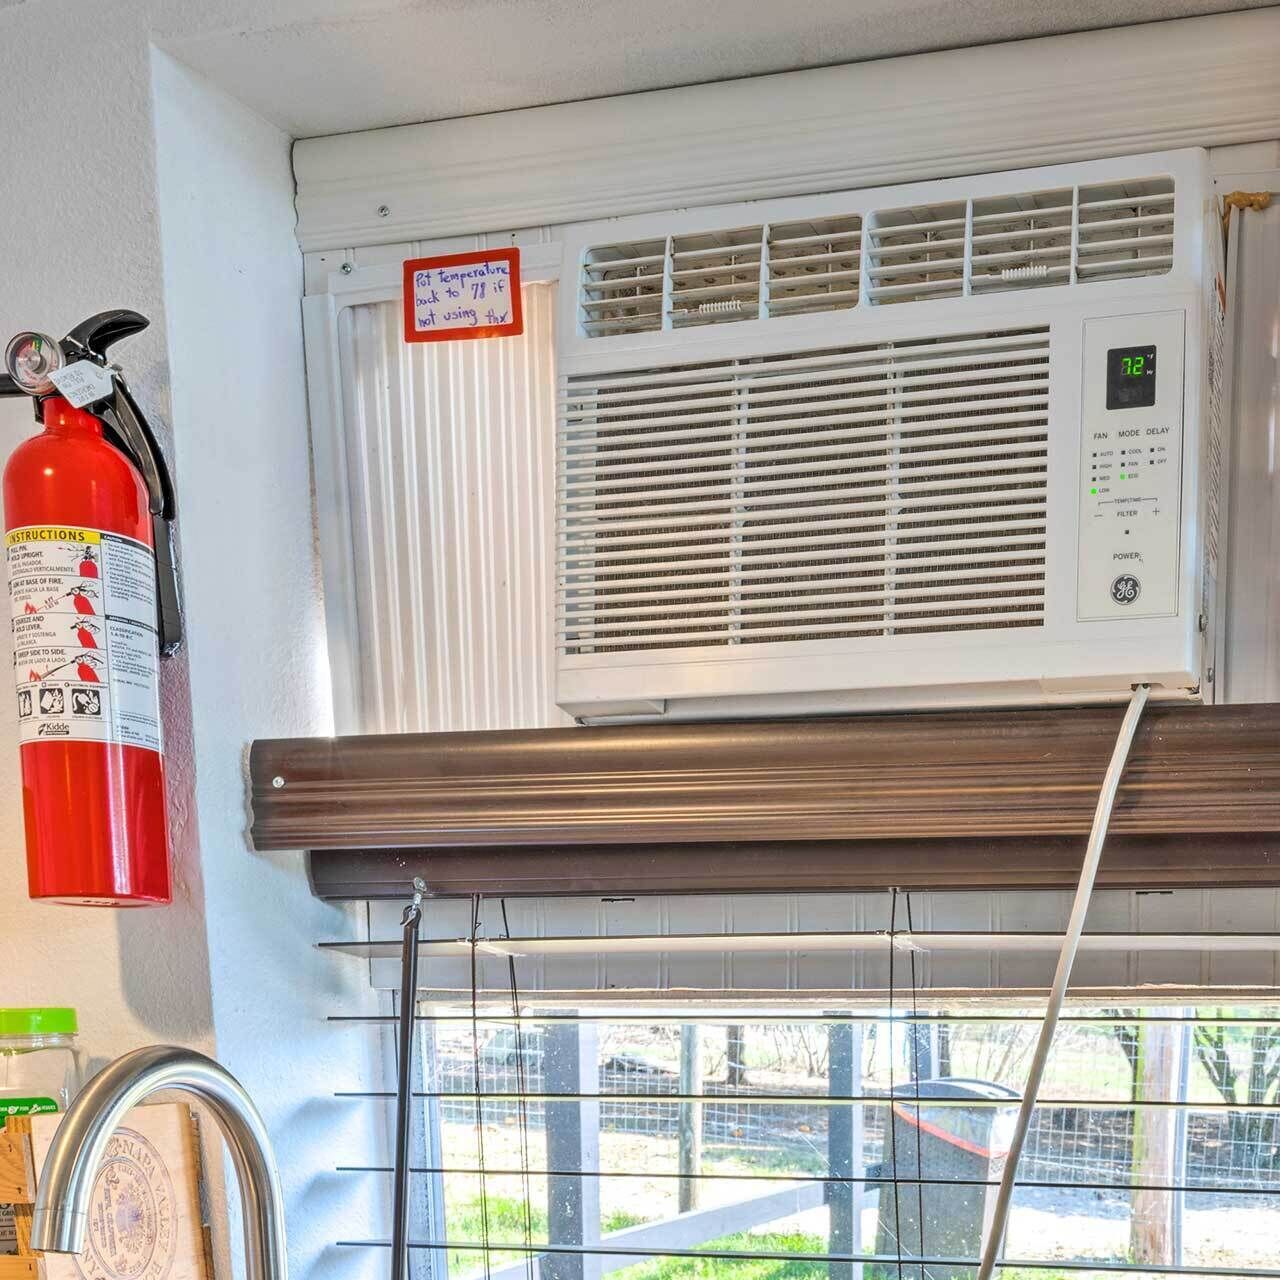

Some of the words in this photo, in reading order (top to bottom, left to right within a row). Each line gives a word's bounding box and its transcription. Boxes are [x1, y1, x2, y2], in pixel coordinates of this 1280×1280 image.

[438, 260, 510, 289] temperature
[445, 286, 460, 298] to
[471, 281, 486, 300] 78
[493, 279, 505, 294] if
[417, 308, 436, 328] not
[443, 305, 478, 326] using
[1122, 356, 1144, 376] 72
[1093, 432, 1108, 440] FAN
[1118, 429, 1141, 438] MODE
[1146, 426, 1170, 436] DELAY
[9, 530, 86, 544] INSTRUCTIONS
[1112, 551, 1140, 560] POWER
[46, 722, 70, 731] Kidde
[155, 1184, 170, 1254] VALLEY
